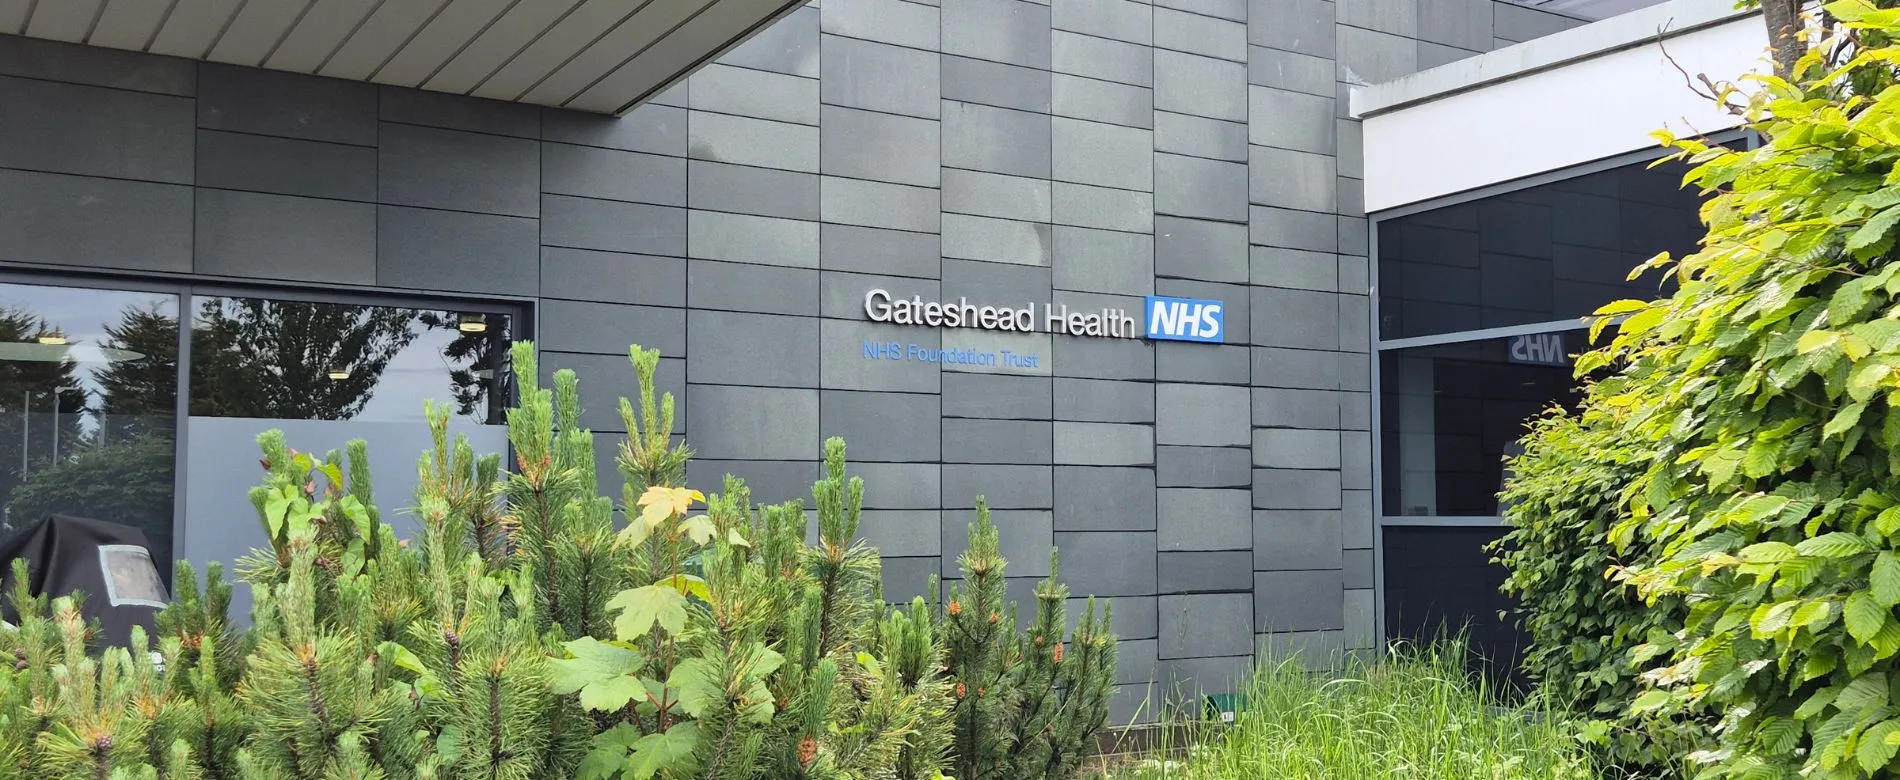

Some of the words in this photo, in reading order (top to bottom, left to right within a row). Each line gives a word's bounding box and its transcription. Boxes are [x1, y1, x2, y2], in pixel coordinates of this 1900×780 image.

[864, 288, 1035, 332] Gateshead
[1044, 303, 1136, 339] Health
[1149, 300, 1222, 339] NHS
[862, 340, 902, 361] NHS
[906, 343, 996, 366] Foundation
[1000, 349, 1039, 368] Trust
